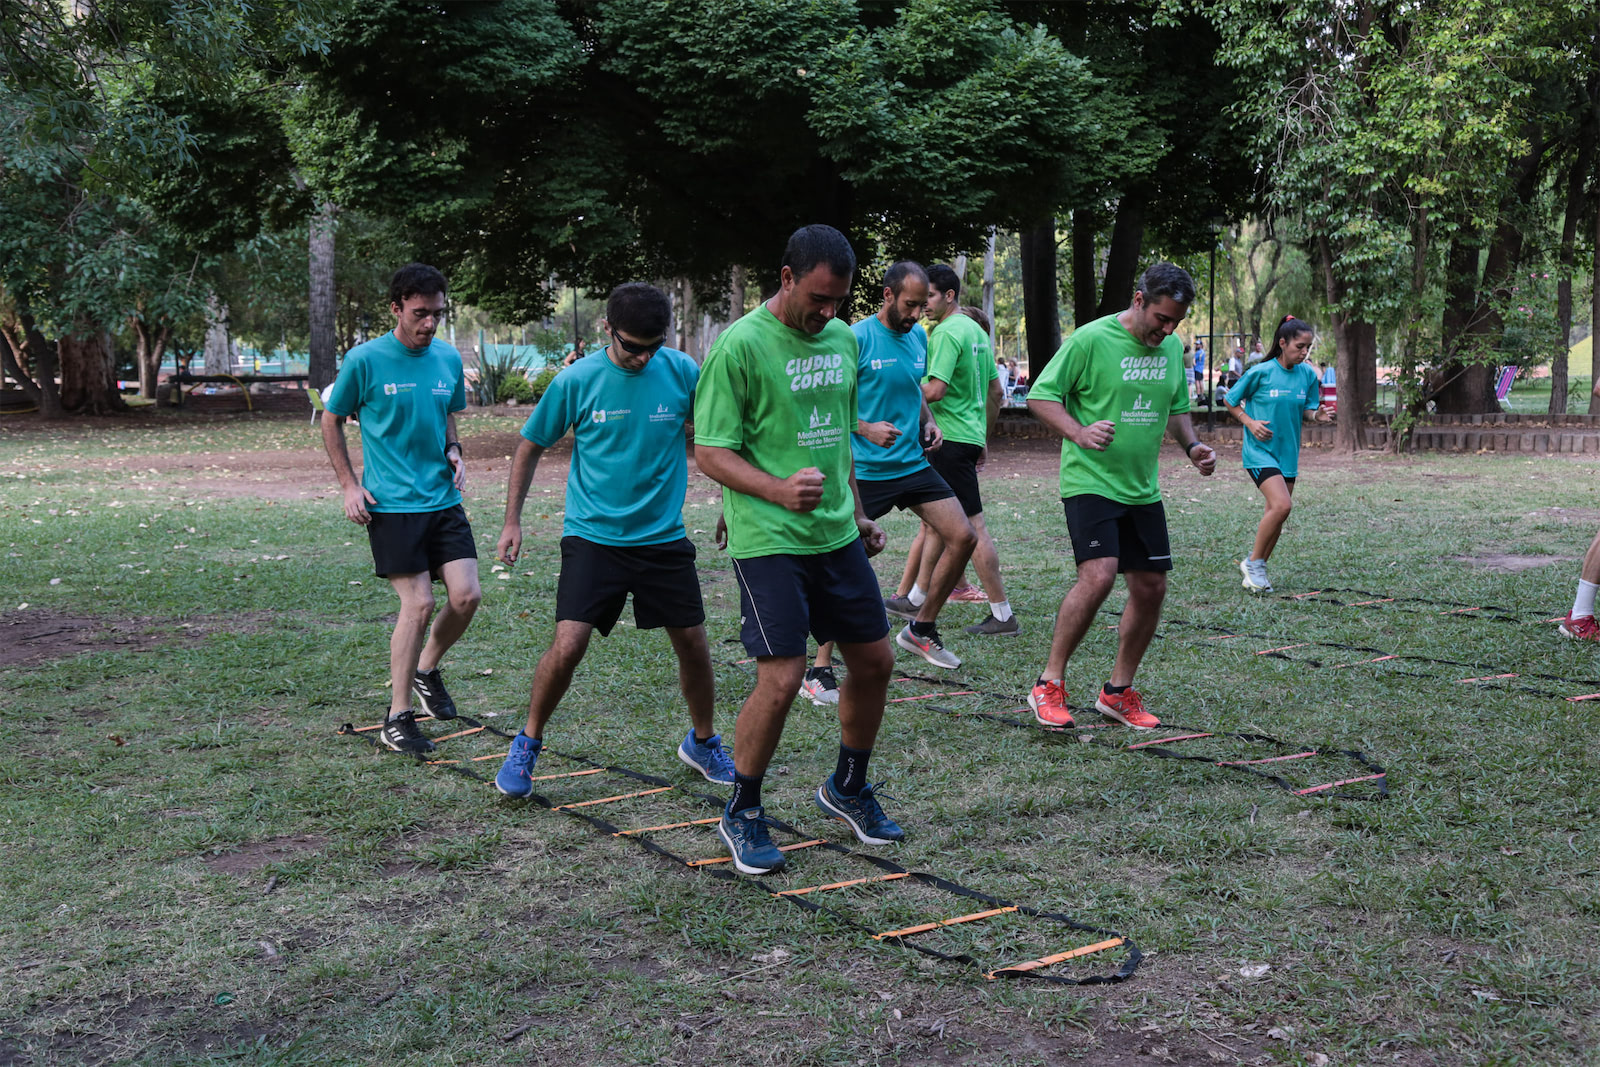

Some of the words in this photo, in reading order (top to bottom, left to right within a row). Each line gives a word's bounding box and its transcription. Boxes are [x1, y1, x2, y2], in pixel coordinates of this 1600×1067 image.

[785, 354, 842, 376] CIUDAD
[1120, 356, 1168, 369] CIUDAD
[790, 369, 843, 392] CORRE
[1122, 368, 1167, 381] CORRE
